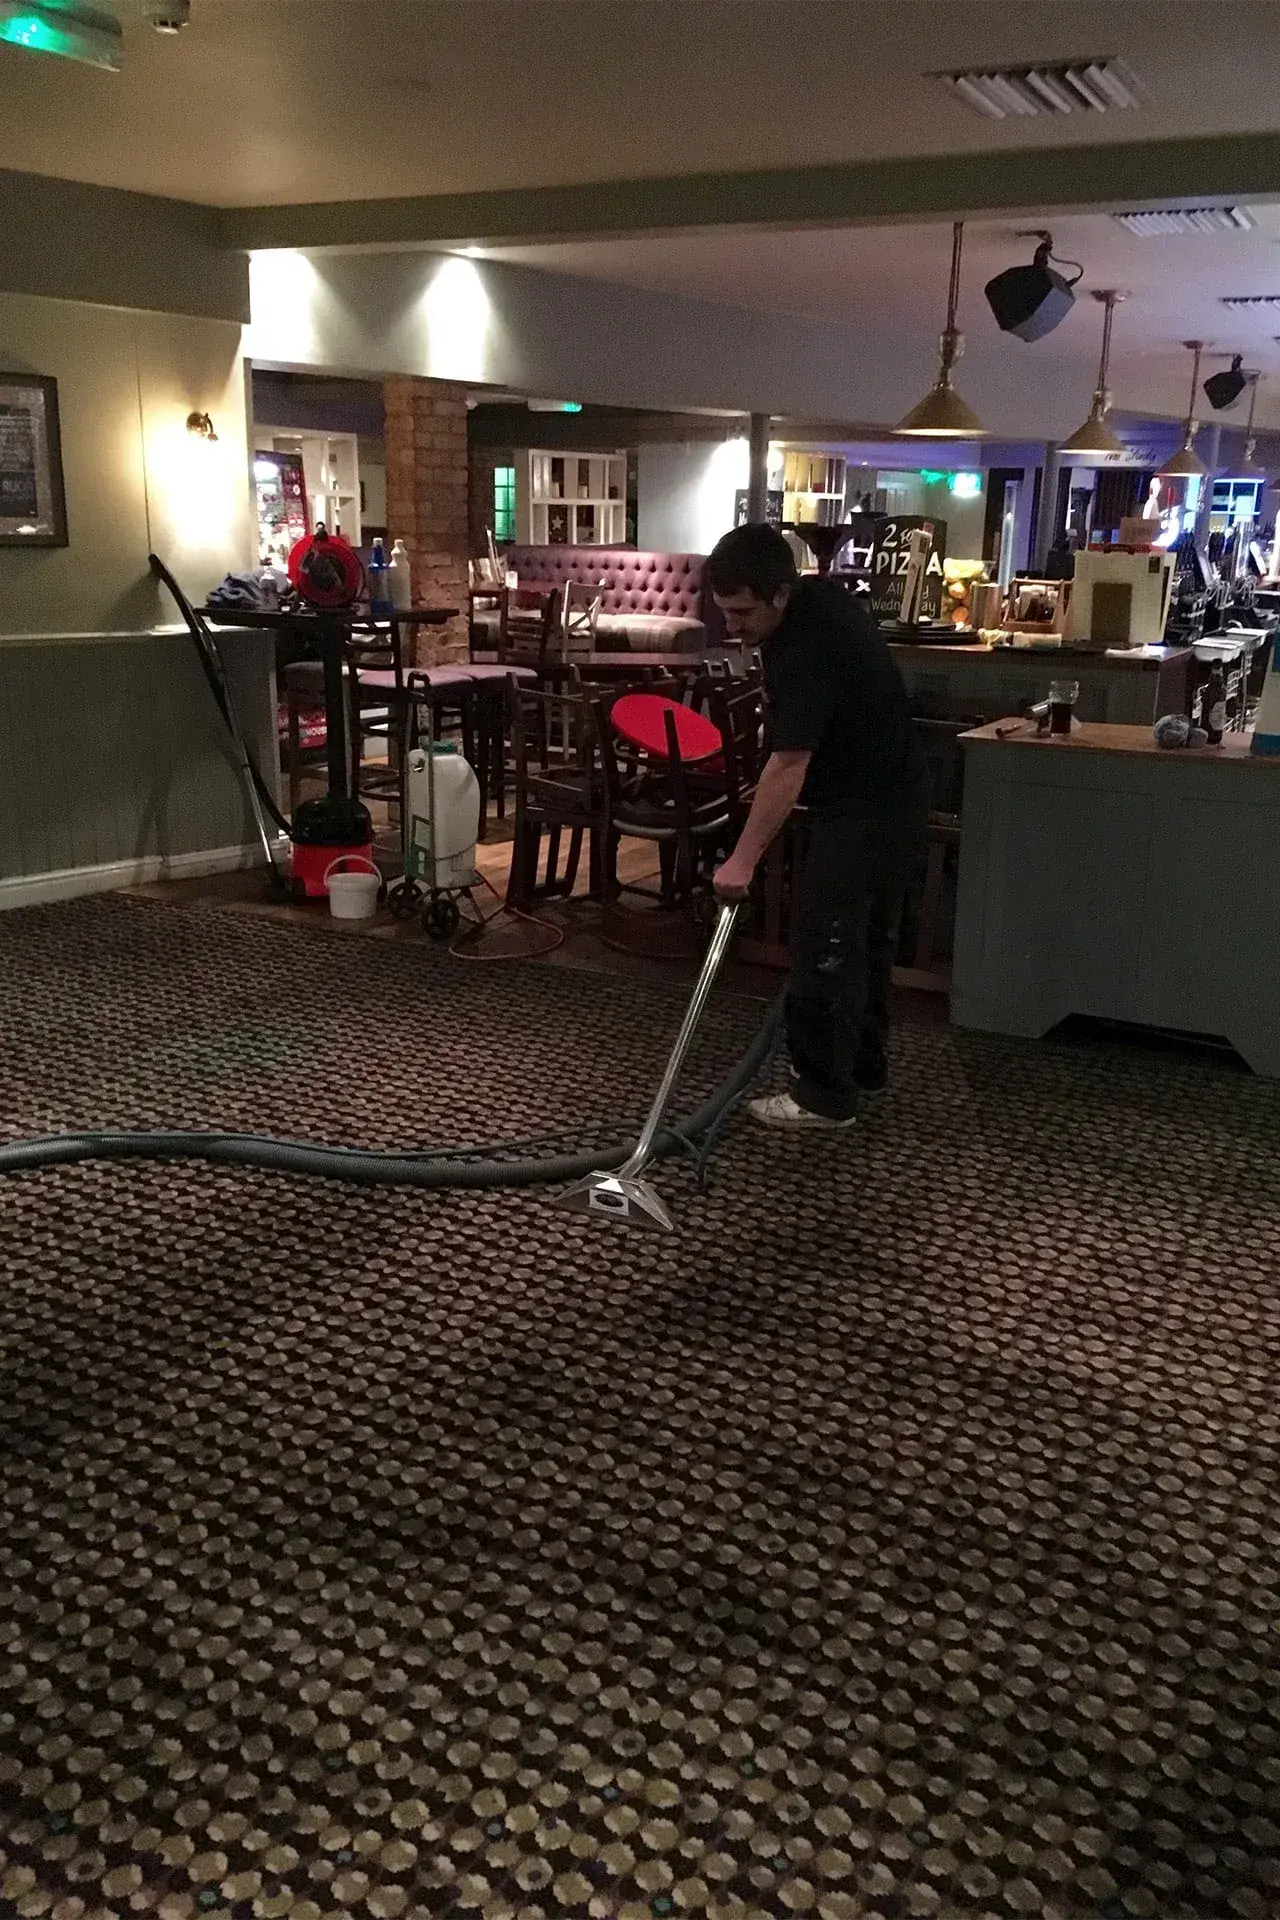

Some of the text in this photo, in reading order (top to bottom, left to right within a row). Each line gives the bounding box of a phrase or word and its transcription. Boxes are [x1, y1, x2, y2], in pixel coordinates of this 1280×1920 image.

[882, 523, 898, 548] 2
[876, 551, 943, 577] PIZA
[886, 581, 904, 596] All
[871, 596, 936, 618] Wednay
